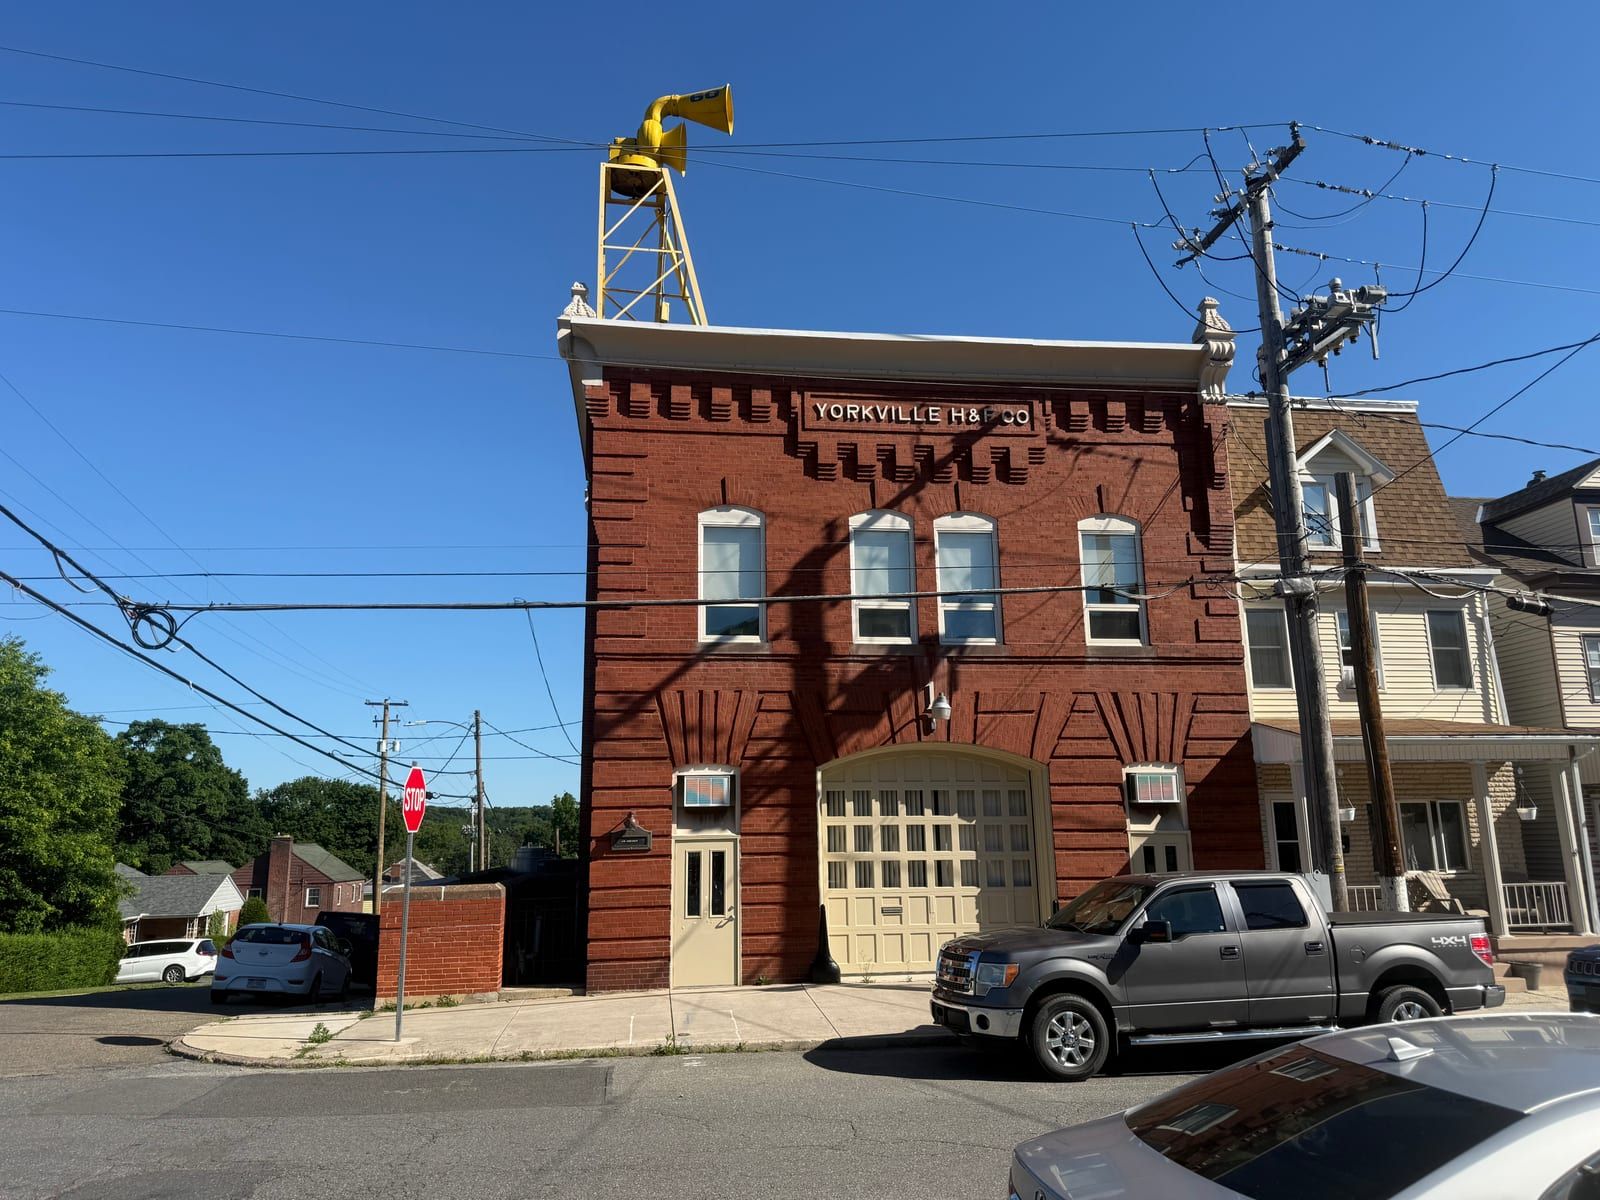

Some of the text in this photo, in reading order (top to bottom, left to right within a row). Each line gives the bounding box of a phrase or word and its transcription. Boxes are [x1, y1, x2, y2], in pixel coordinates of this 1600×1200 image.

[815, 402, 1030, 424] YORKVILLE H&F CO
[404, 787, 425, 811] STOP
